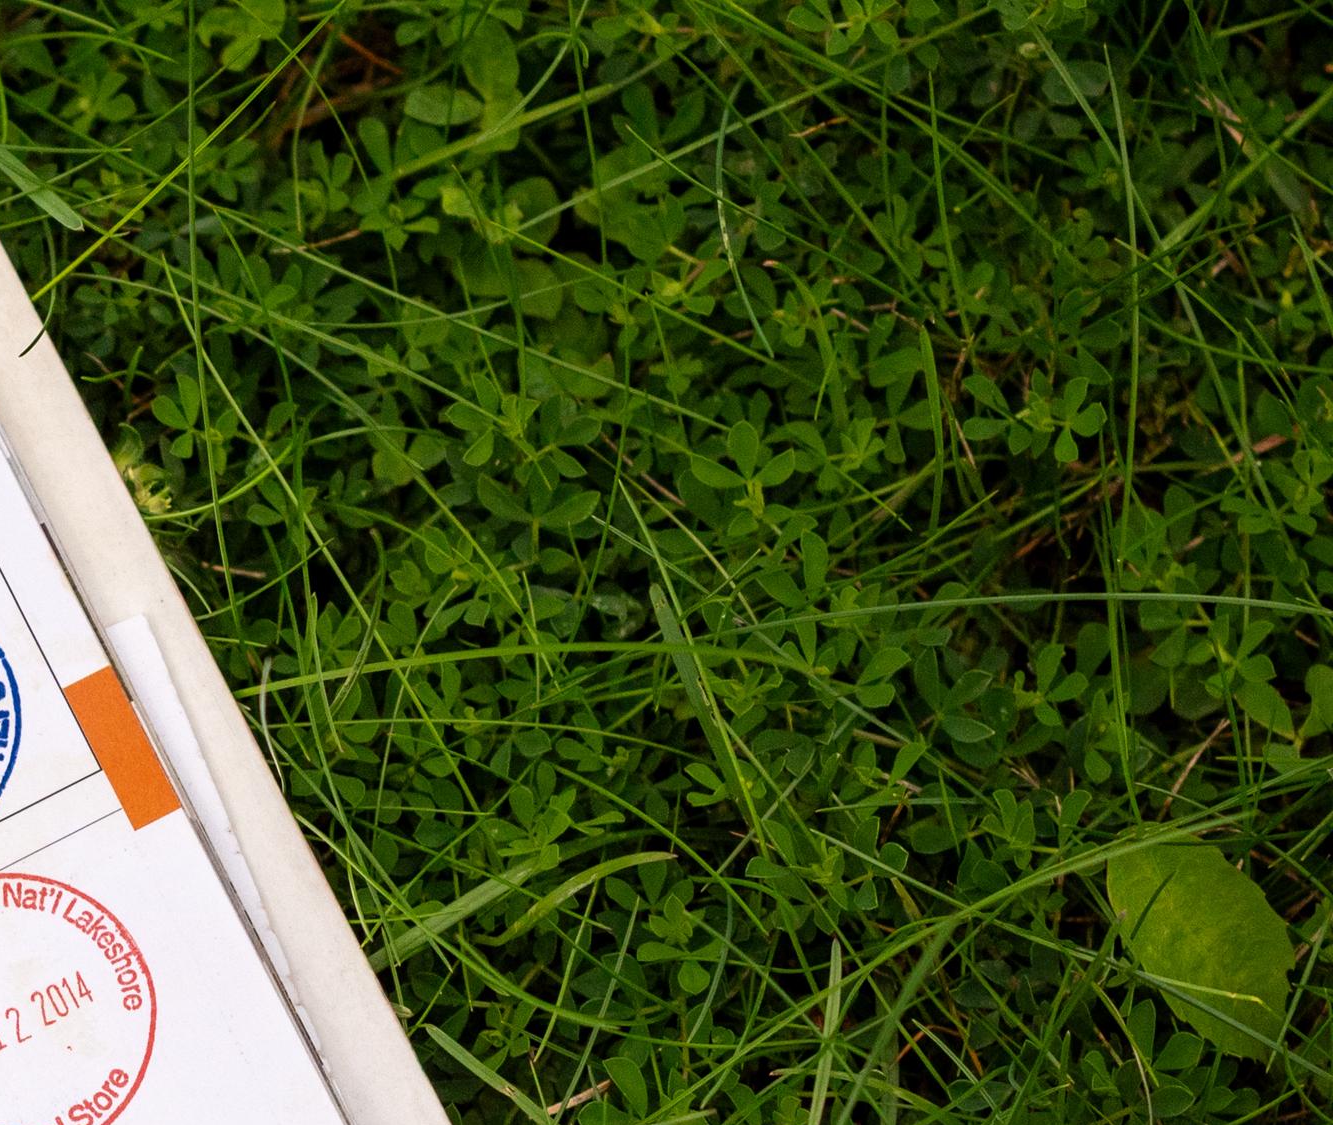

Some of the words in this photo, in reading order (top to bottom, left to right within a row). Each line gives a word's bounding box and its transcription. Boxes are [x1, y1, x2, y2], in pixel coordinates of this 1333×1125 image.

[2, 882, 63, 914] Nat'l
[63, 898, 142, 1011] Lakeshore
[31, 971, 94, 1026] 2014
